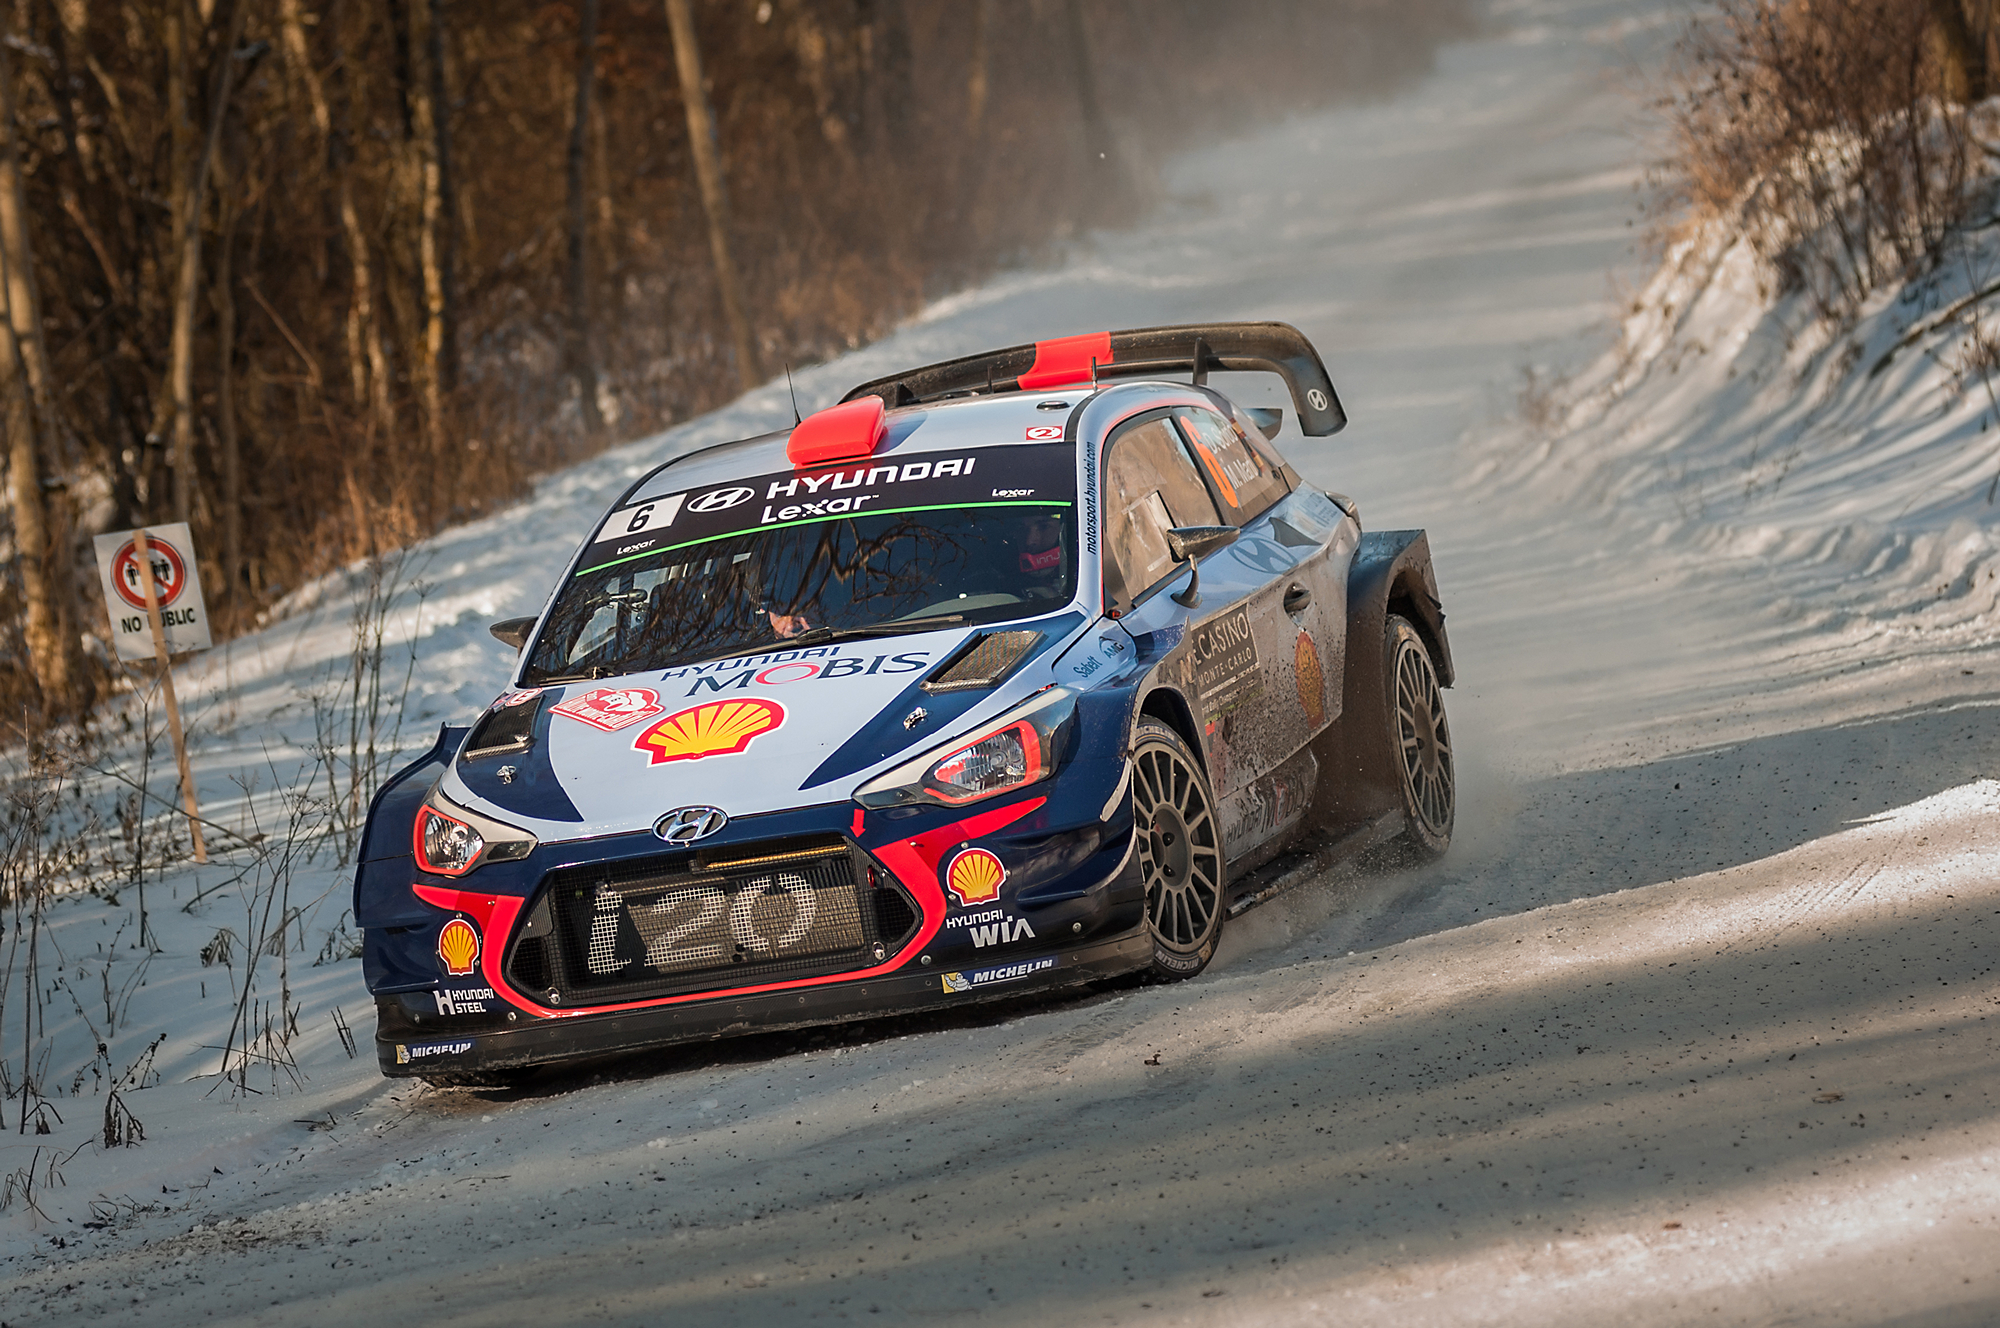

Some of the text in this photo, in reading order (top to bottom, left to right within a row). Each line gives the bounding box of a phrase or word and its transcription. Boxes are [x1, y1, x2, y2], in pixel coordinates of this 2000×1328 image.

[766, 458, 976, 500] HYUNDAI
[992, 488, 1035, 498] Lexar
[761, 496, 872, 524] Lexar
[1083, 441, 1097, 555] motorsport.hyundai.com
[627, 504, 655, 532] 6
[617, 539, 656, 555] Lexar
[121, 607, 196, 633] NO BLIC
[1198, 612, 1249, 660] CASINO
[660, 647, 841, 682] HYUNDAI
[683, 652, 930, 697] MOBIS
[946, 909, 1004, 928] HYUNDAI
[969, 915, 1036, 948] WIA
[973, 959, 1053, 984] MICHELIN
[452, 988, 495, 1001] HYUNDAI
[455, 1002, 487, 1013] STEEL
